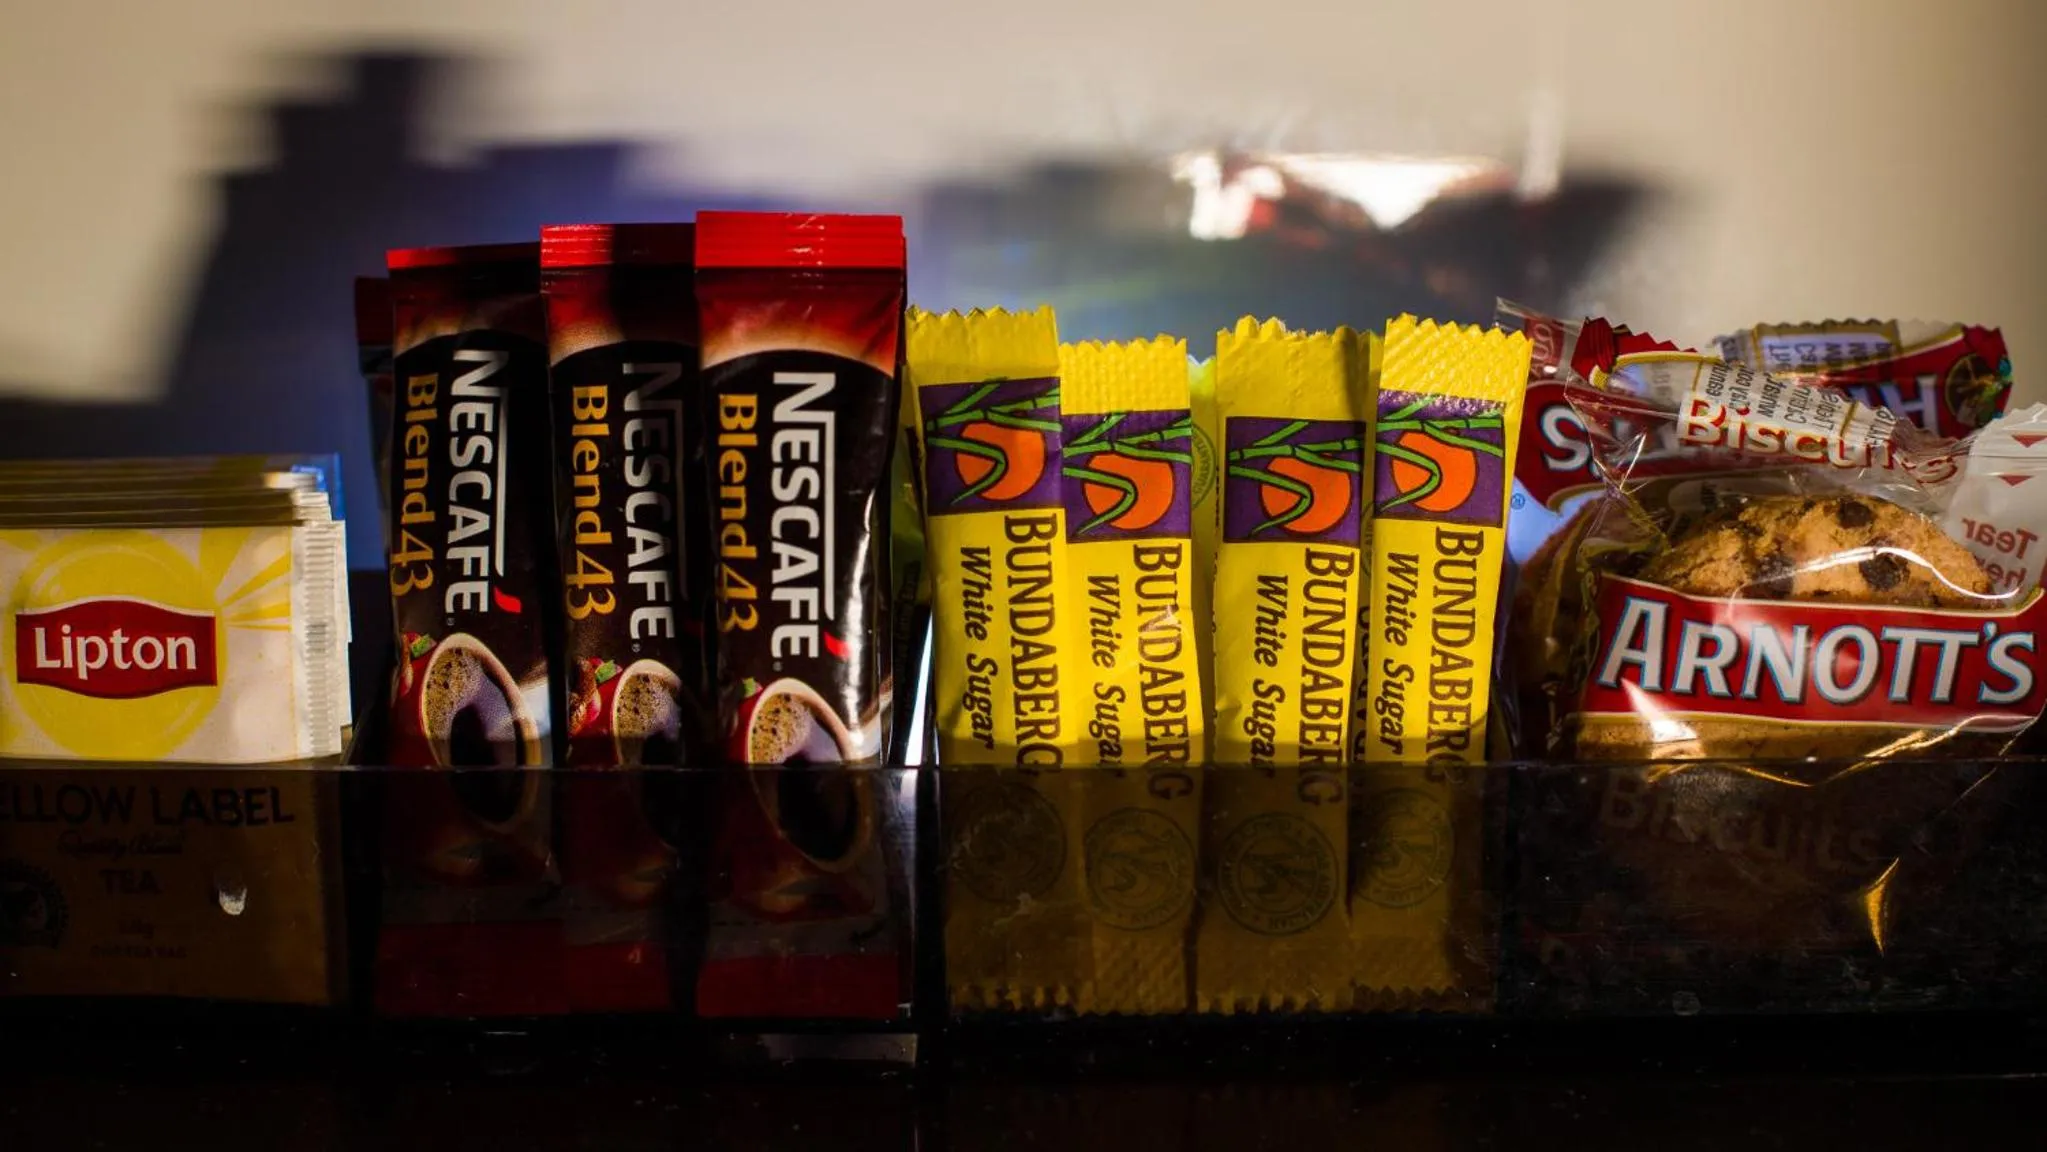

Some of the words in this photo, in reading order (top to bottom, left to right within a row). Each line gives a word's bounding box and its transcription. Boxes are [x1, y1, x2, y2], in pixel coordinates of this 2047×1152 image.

[401, 371, 440, 525] Blend
[571, 384, 613, 546] Blend
[717, 392, 760, 560] Blend
[390, 527, 436, 598] 43
[565, 549, 618, 622] 43
[714, 561, 761, 634] 43
[961, 545, 993, 642] White
[1384, 551, 1420, 648] White
[34, 623, 198, 681] Lipton
[1004, 512, 1064, 776] BUNDABERG
[1087, 573, 1123, 669] White
[1254, 574, 1289, 668] White
[1425, 525, 1485, 785] BUNDABERG
[1597, 594, 2037, 705] ARNOTT'S
[963, 652, 999, 751] Sugar
[1132, 543, 1195, 800] BUNDABERG
[1298, 547, 1356, 806] BUNDABERG
[1374, 658, 1415, 756] Sugar
[1089, 681, 1127, 778] Sugar
[1243, 678, 1286, 779] Sugar
[0, 781, 136, 824] LLOW
[150, 785, 295, 827] LABEL
[98, 868, 164, 895] TEA
